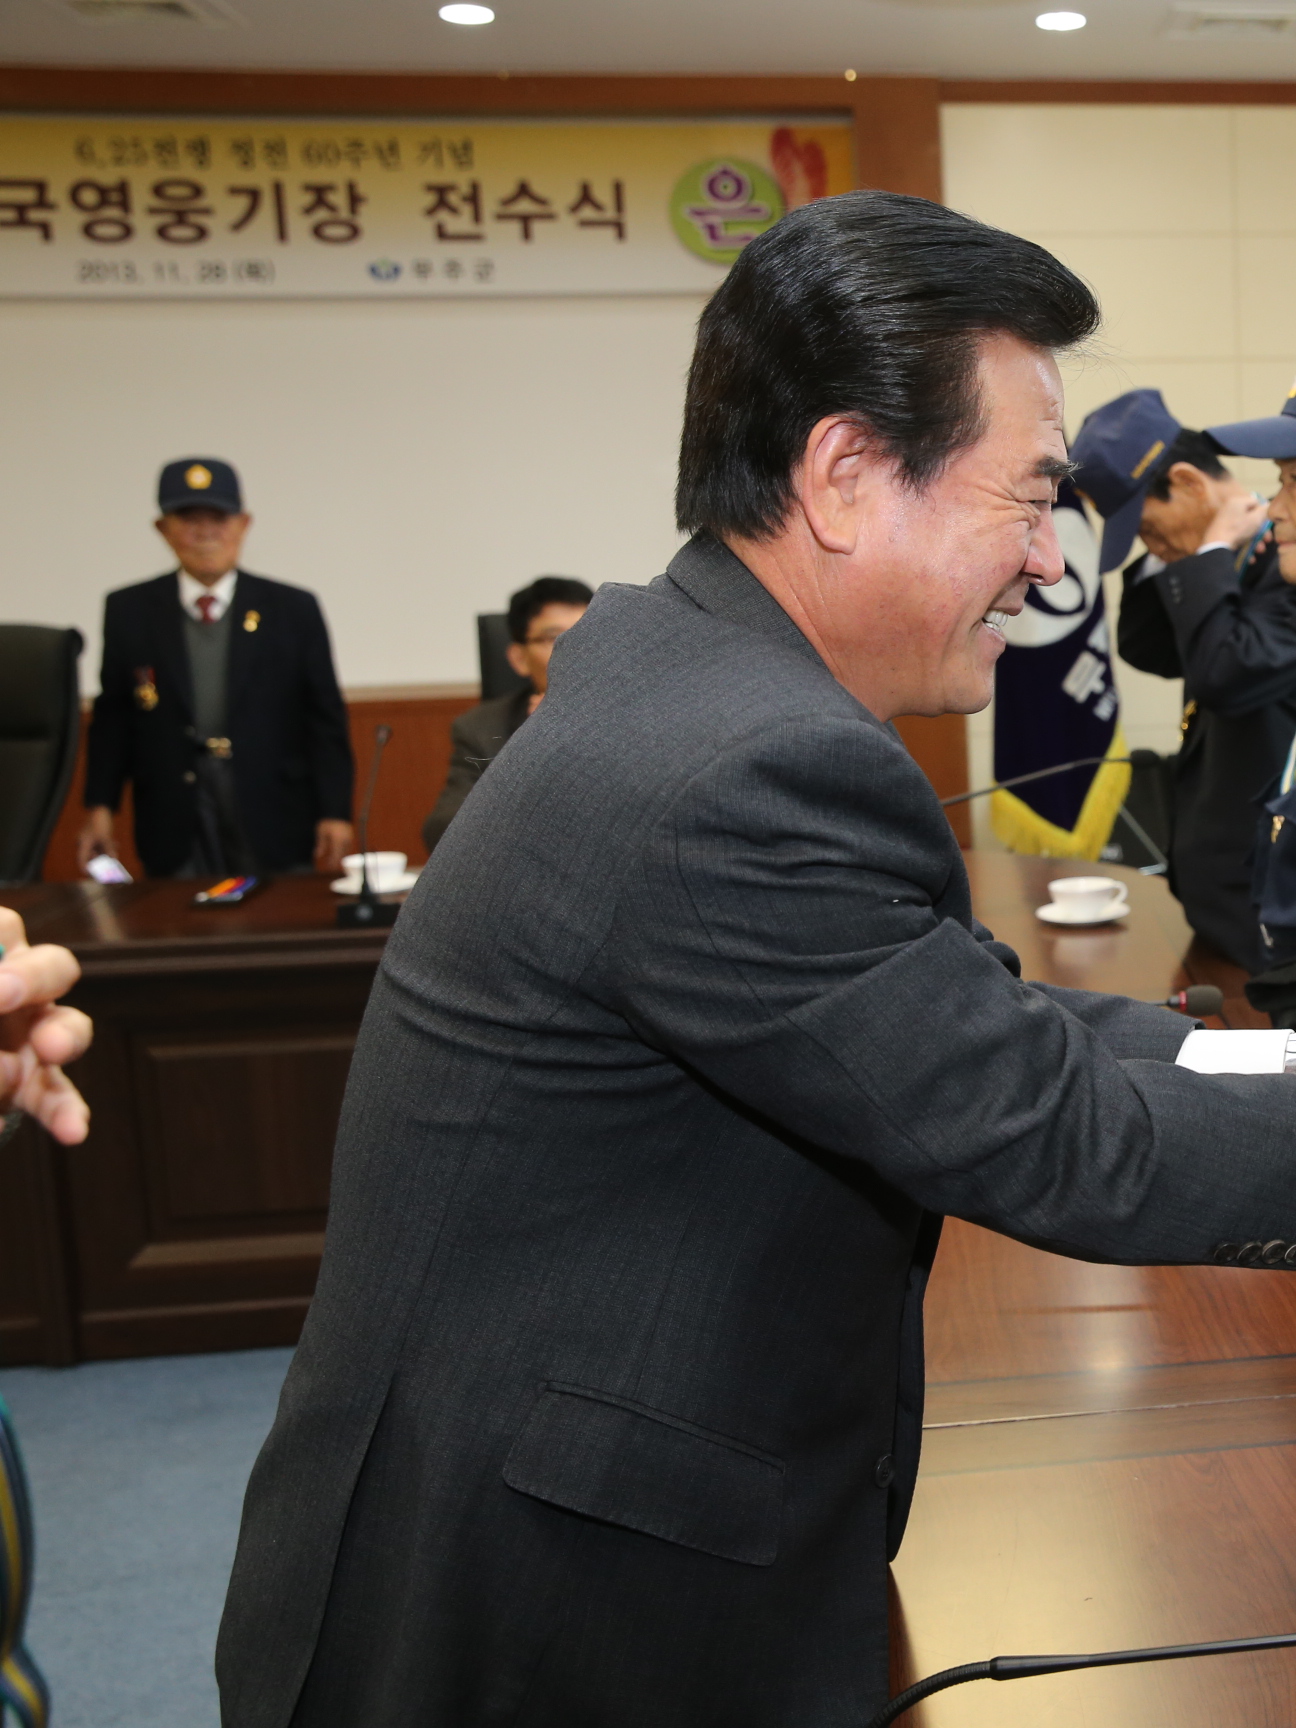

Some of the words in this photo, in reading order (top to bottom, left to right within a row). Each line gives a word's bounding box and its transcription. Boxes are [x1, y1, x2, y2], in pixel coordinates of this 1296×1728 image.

[301, 137, 400, 170] 60주년
[418, 137, 474, 170] 기념
[0, 177, 367, 245] 국영웅기장
[423, 178, 627, 243] 전수식
